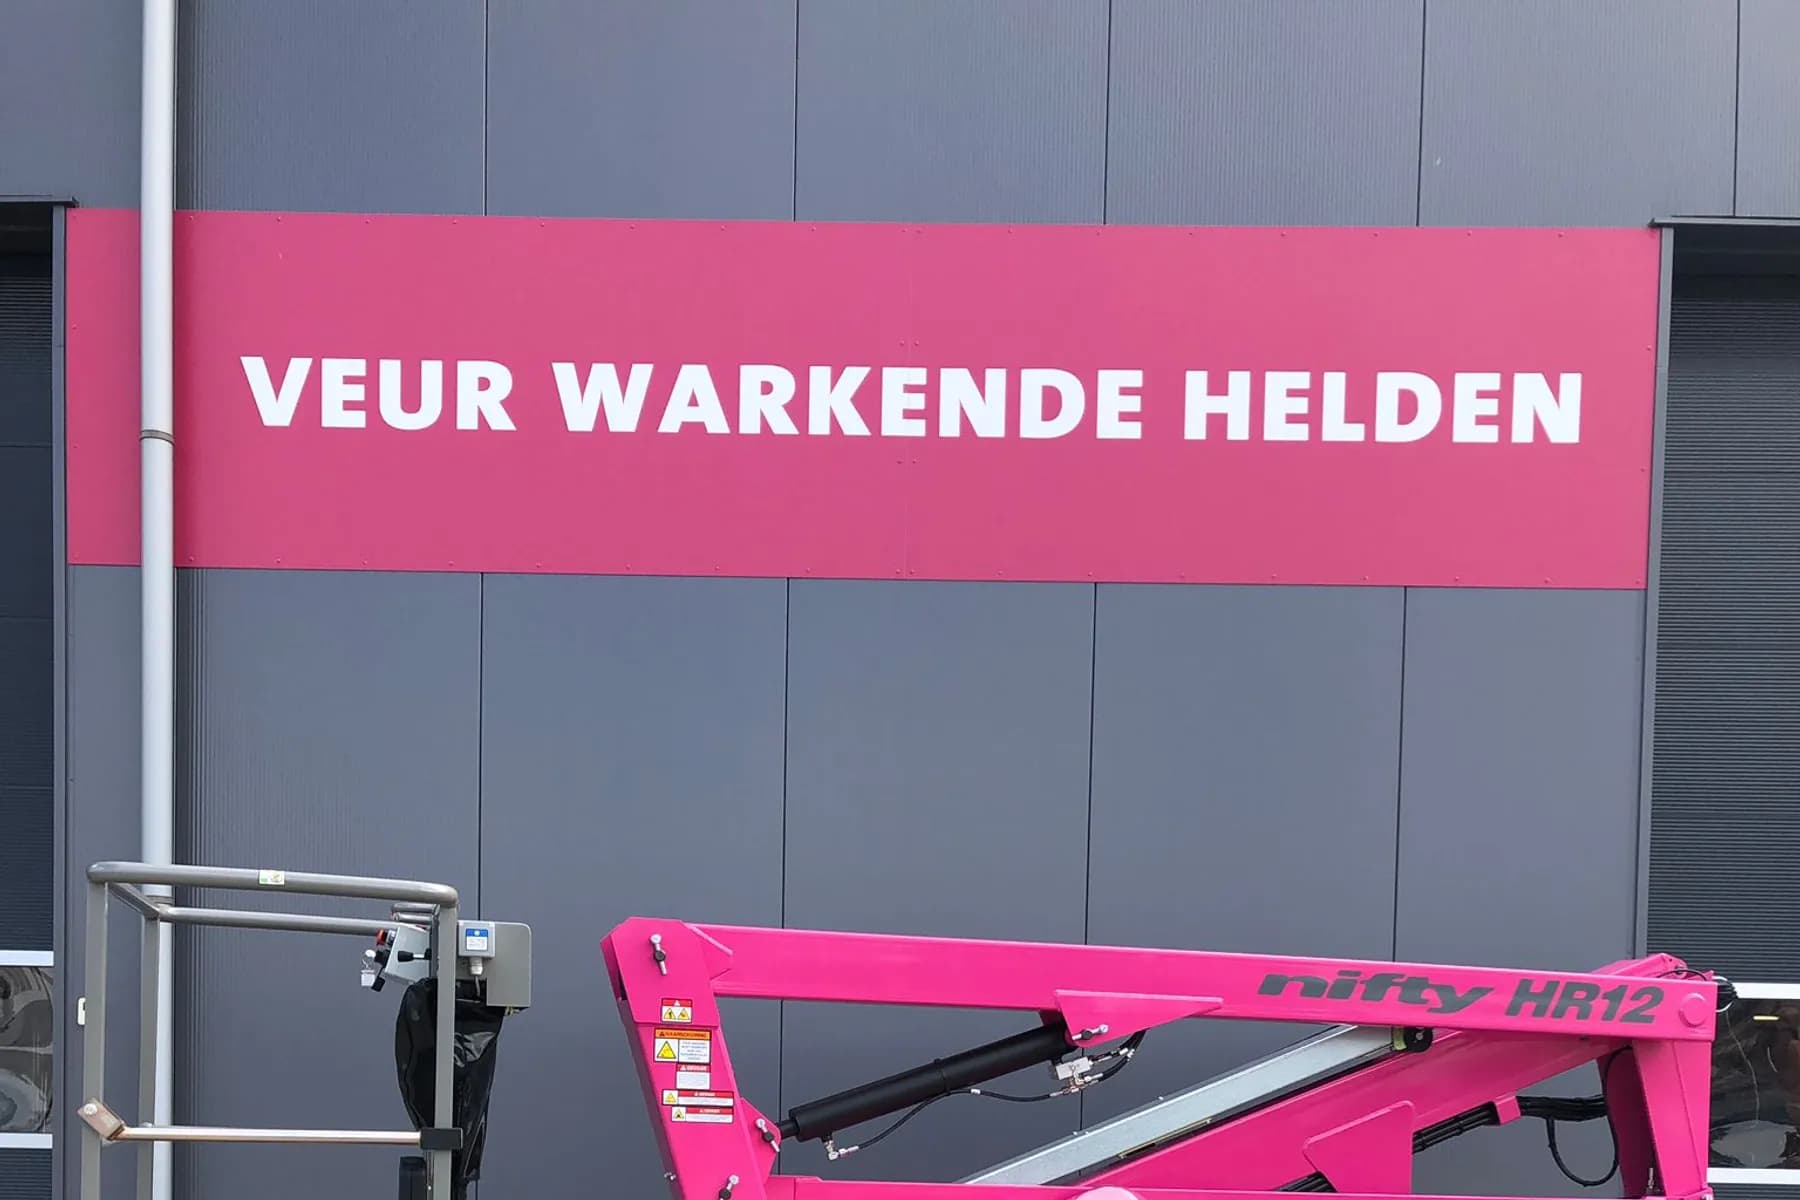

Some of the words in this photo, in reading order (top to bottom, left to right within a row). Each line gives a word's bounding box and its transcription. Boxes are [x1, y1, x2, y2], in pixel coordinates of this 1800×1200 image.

[241, 357, 516, 431] VEUR
[552, 363, 1143, 440] WARKENDE
[1184, 371, 1582, 444] HELDEN
[1257, 970, 1494, 1014] nifty
[1505, 979, 1664, 1024] HR12
